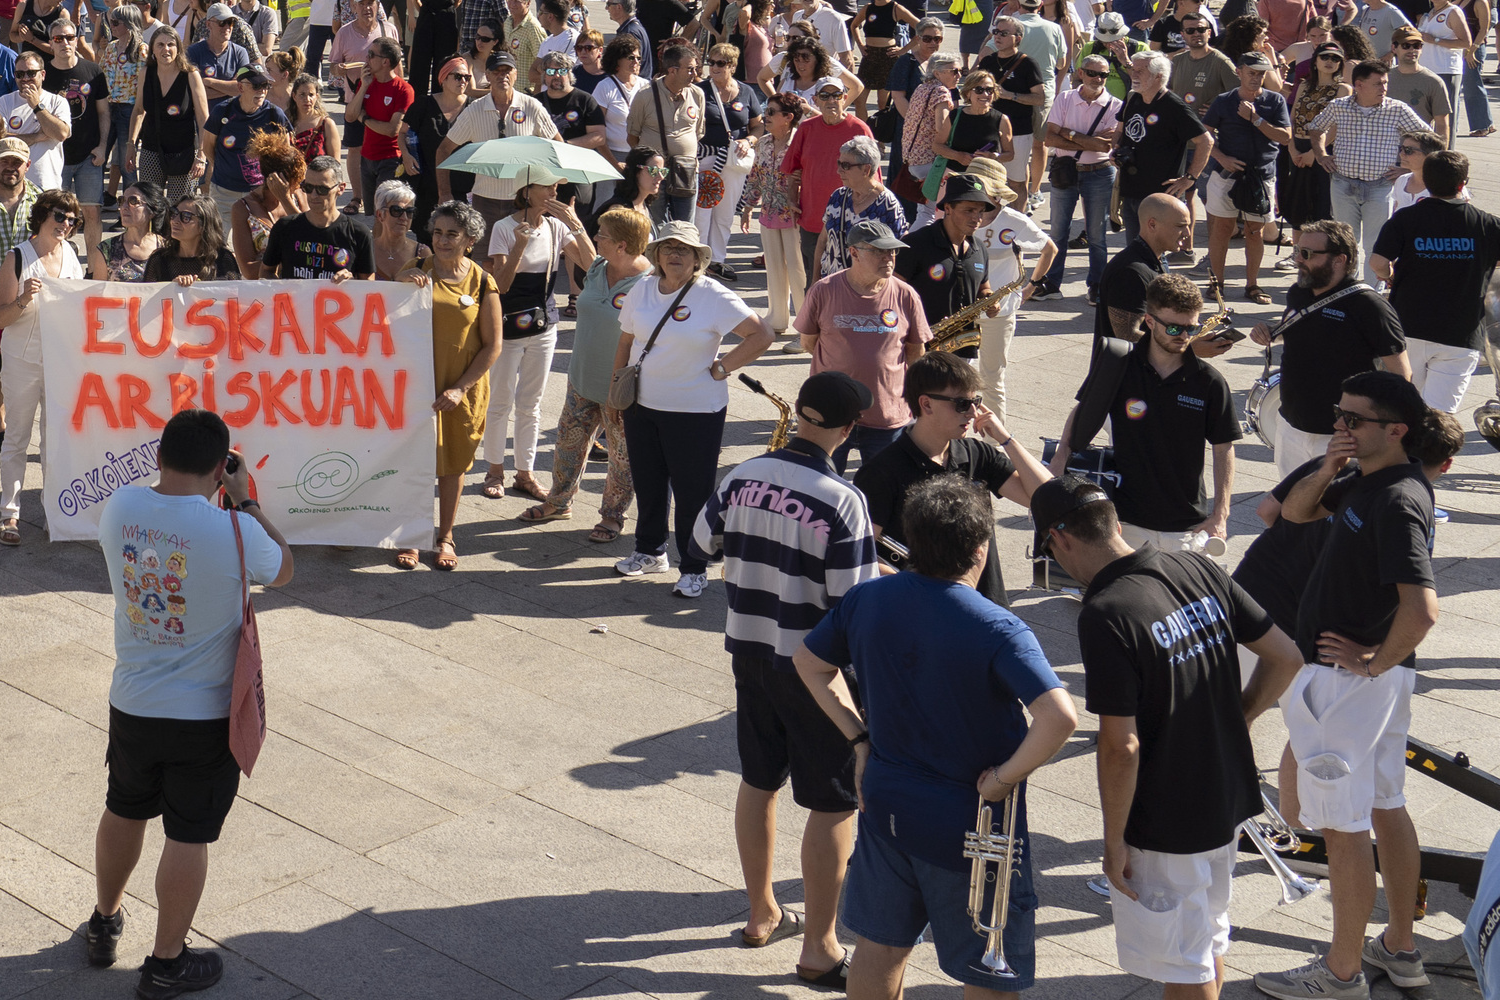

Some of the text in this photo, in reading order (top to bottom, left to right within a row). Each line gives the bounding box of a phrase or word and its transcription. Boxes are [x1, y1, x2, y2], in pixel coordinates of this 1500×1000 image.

[294, 240, 340, 256] euskara
[1414, 237, 1475, 252] GAUERDI
[306, 254, 325, 268] bizi
[1415, 252, 1475, 260] TXARANGA
[293, 266, 314, 279] nahi
[84, 289, 395, 360] EUSKARA
[1177, 394, 1205, 407] GAUERDI
[122, 524, 192, 551] MARUXAK
[1151, 595, 1227, 650] GAUERDI
